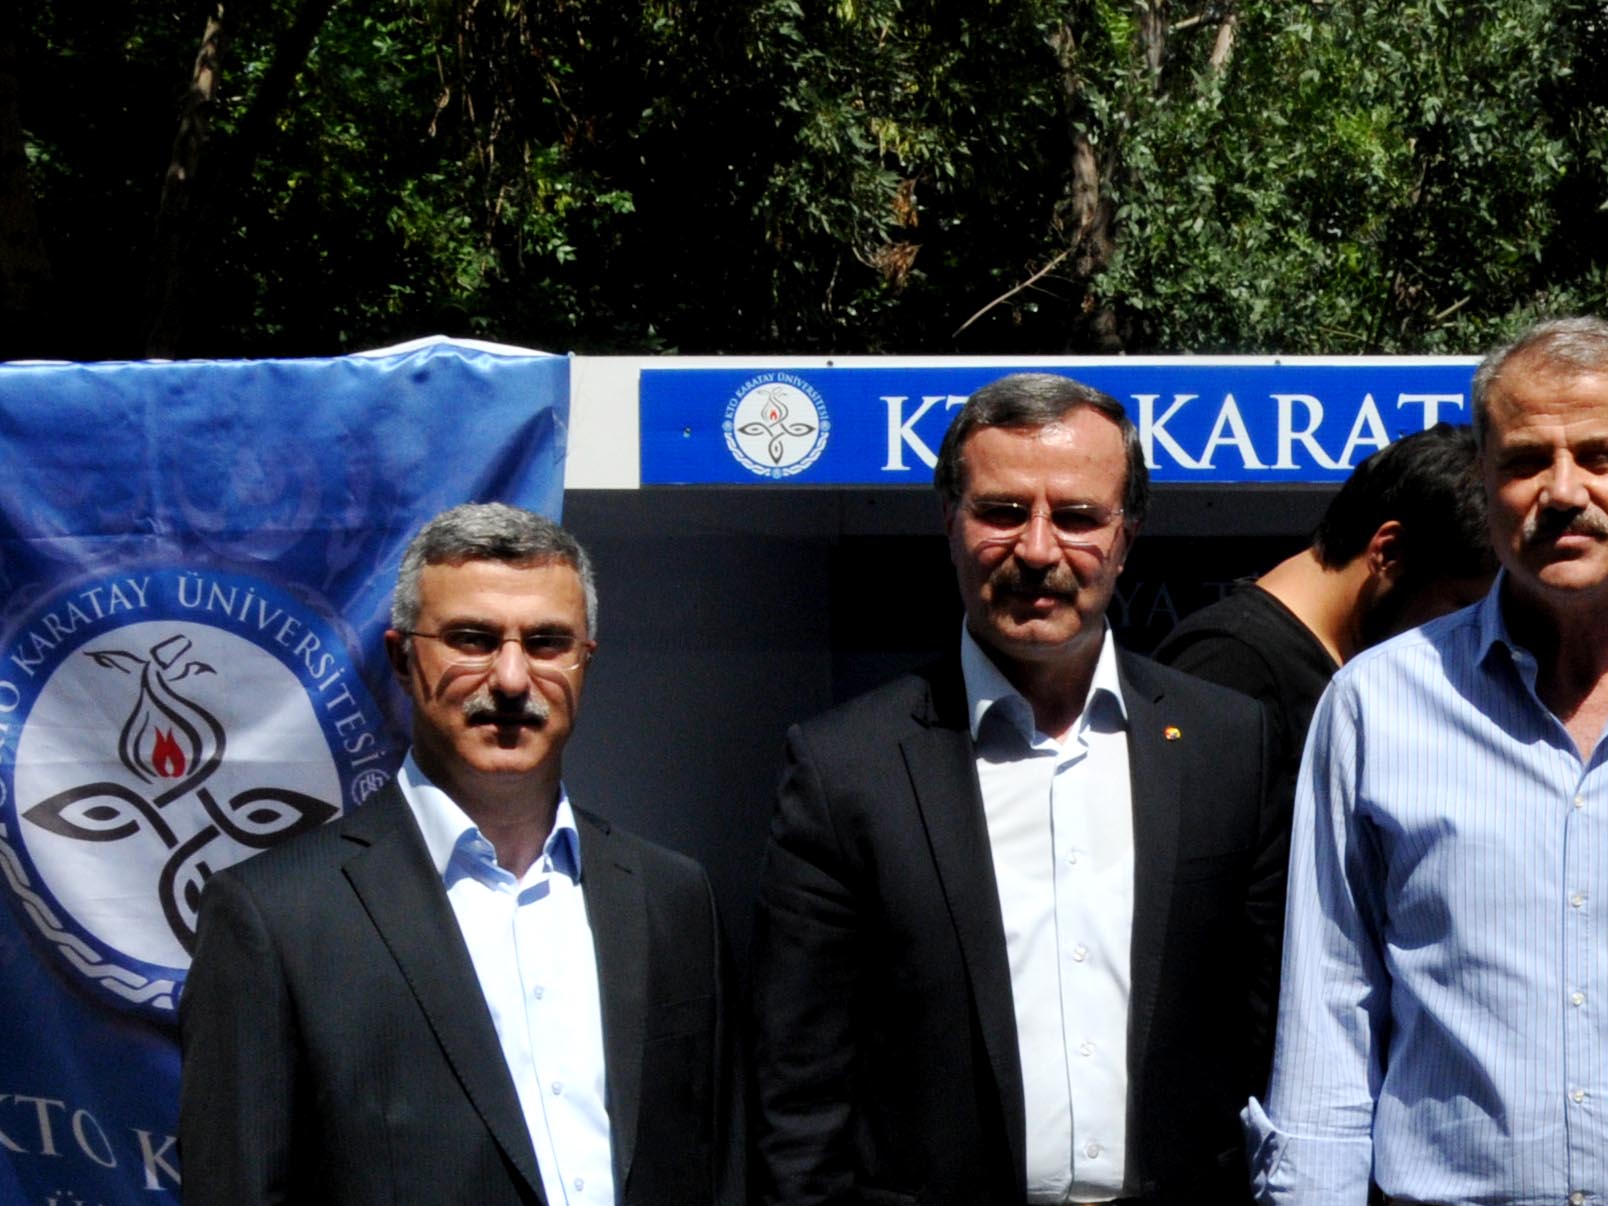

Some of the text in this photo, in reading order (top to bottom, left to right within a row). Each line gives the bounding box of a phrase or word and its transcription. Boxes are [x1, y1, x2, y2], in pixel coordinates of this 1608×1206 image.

[735, 372, 776, 397] KARATAY
[1131, 392, 1464, 470] KARAT
[11, 576, 152, 677] KARATAY
[177, 571, 387, 768] ÜNİVERSİTESİ
